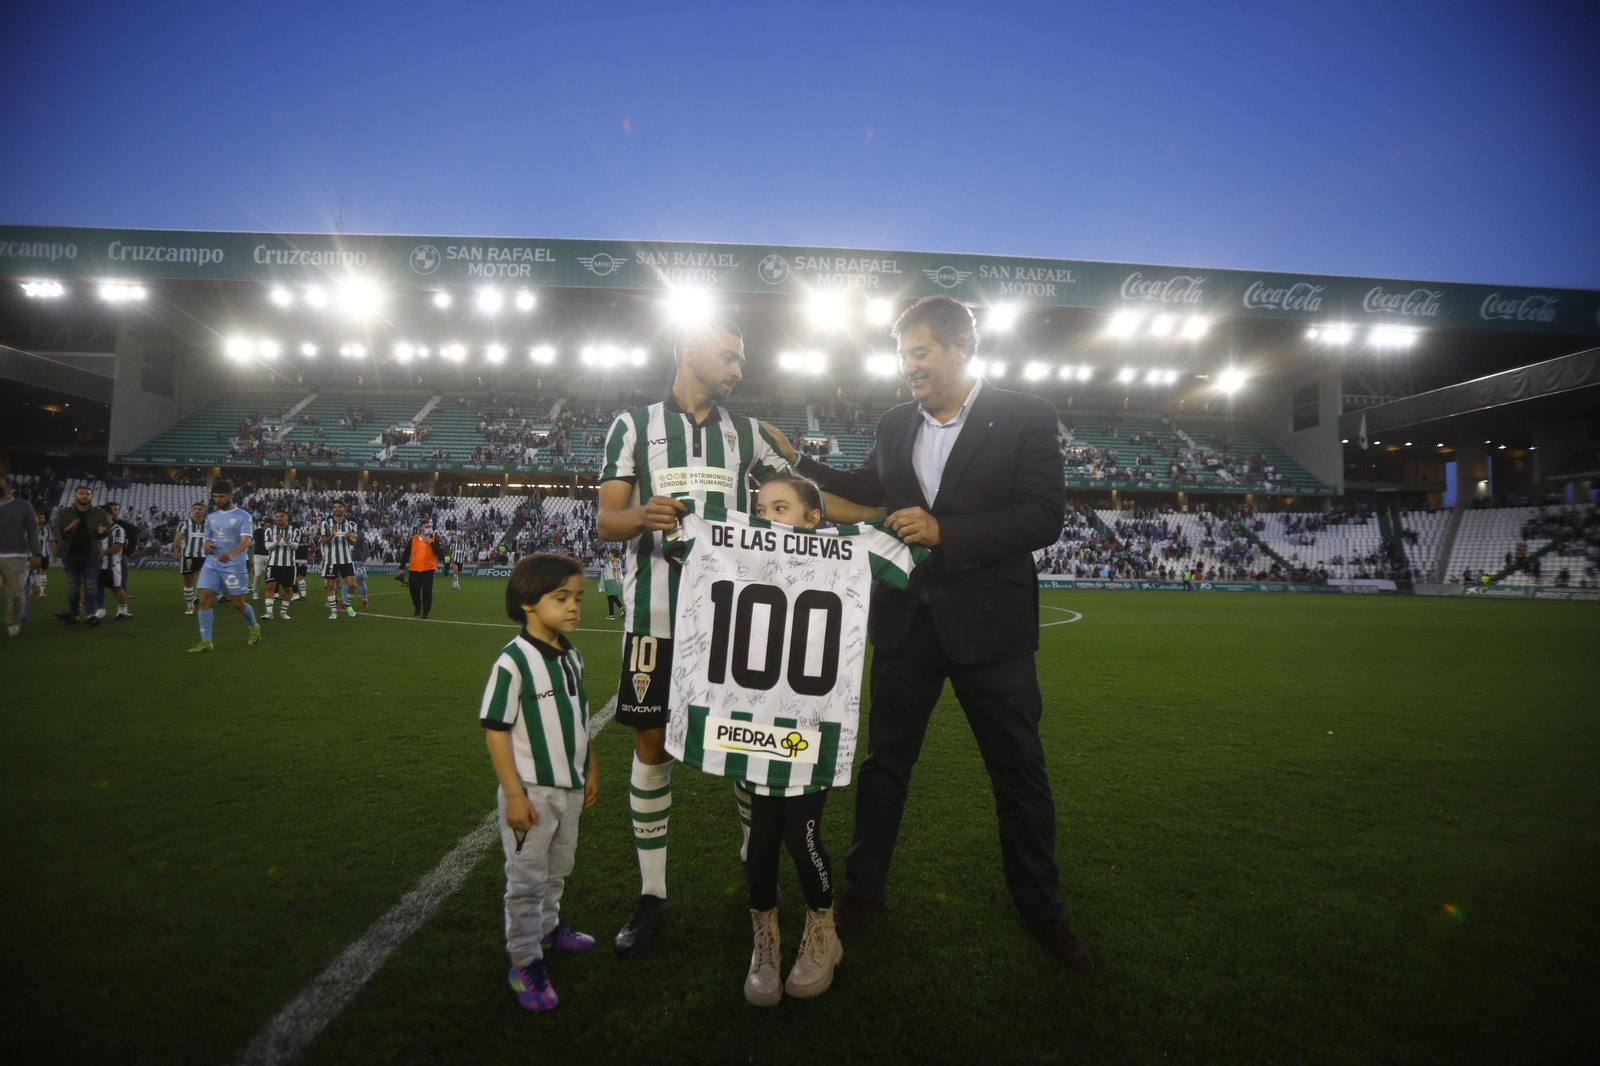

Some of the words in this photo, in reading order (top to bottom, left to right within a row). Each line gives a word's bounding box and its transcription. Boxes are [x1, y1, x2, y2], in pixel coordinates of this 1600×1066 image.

[108, 240, 224, 267] Cruzcampo
[253, 244, 367, 269] Cruzcampo
[446, 246, 482, 260] SAN
[487, 247, 556, 262] RAFAEL
[636, 251, 669, 265] SAN
[674, 252, 738, 267] RAFAEL
[468, 263, 532, 278] MOTOR
[795, 256, 831, 270] SAN
[835, 257, 903, 274] RAFAEL
[656, 268, 718, 282] MOTOR
[817, 273, 880, 288] MOTOR
[939, 273, 957, 281] MINI
[979, 265, 1011, 279] SAN
[1015, 267, 1076, 283] RAFAEL
[999, 281, 1057, 297] MOTOR
[1120, 272, 1207, 304] Coca-Cola
[1243, 280, 1326, 312] Coca-Cola
[1363, 286, 1444, 317] Coca-Cola
[1479, 292, 1560, 323] Coca-Cola
[121, 455, 147, 463] Cruzcampo
[152, 456, 177, 464] Cruzcampo
[690, 472, 727, 482] PATRIMONIO
[699, 478, 733, 489] HUMANIDAD
[711, 524, 734, 548] DE
[740, 529, 777, 552] LAS
[783, 534, 853, 561] CUEVAS
[146, 560, 182, 570] moua
[1479, 586, 1525, 597] CaixaBank
[708, 580, 843, 697] 100
[629, 635, 658, 673] 10
[621, 703, 661, 714] GIVOVA
[805, 819, 816, 853] CALVIN
[809, 850, 825, 872] KLEIN
[818, 870, 830, 892] JEANS
